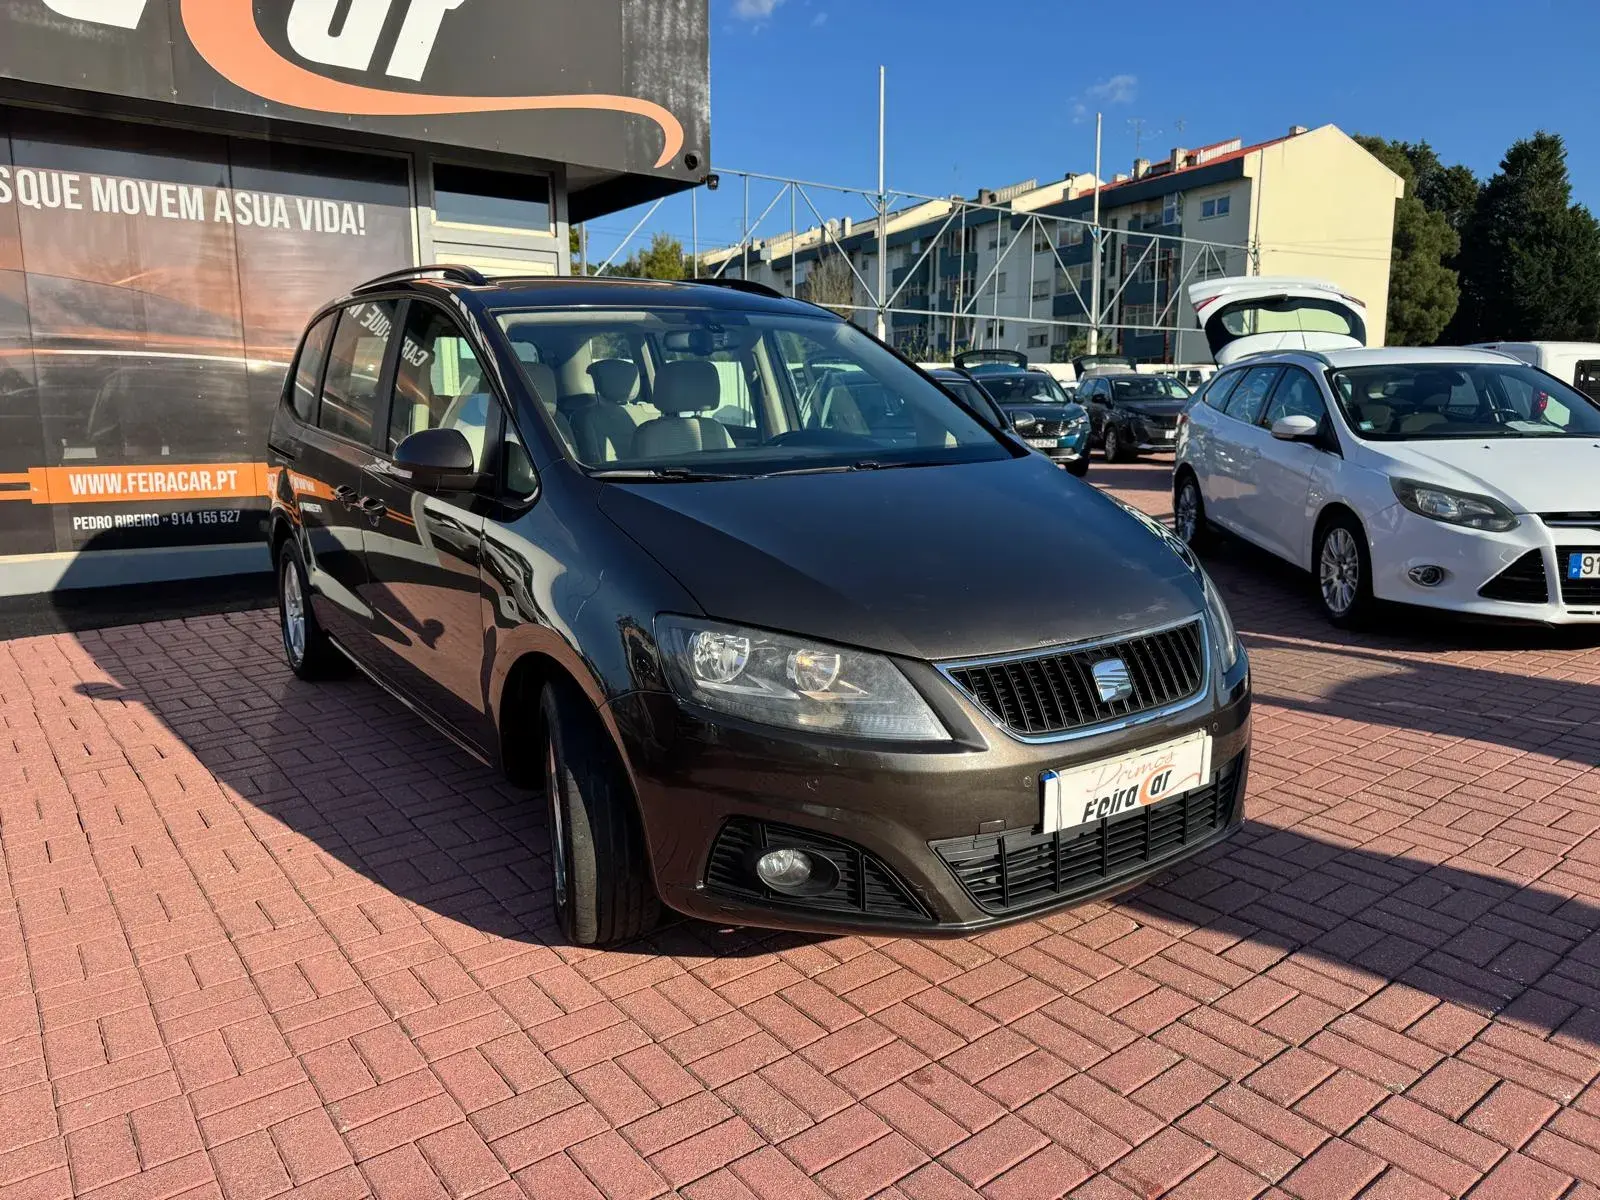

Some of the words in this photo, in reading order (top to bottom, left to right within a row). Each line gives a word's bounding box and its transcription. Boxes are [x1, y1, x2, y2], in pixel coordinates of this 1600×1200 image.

[16, 169, 83, 210] QUE
[90, 176, 205, 221] MOVEM
[296, 197, 366, 236] VIDA!
[69, 470, 238, 495] WWW.FEIRACAR.PT
[73, 515, 112, 530] PEDRO
[115, 513, 160, 528] RIBEIRO
[172, 512, 194, 526] 914
[197, 511, 218, 524] 155
[220, 510, 241, 523] 527
